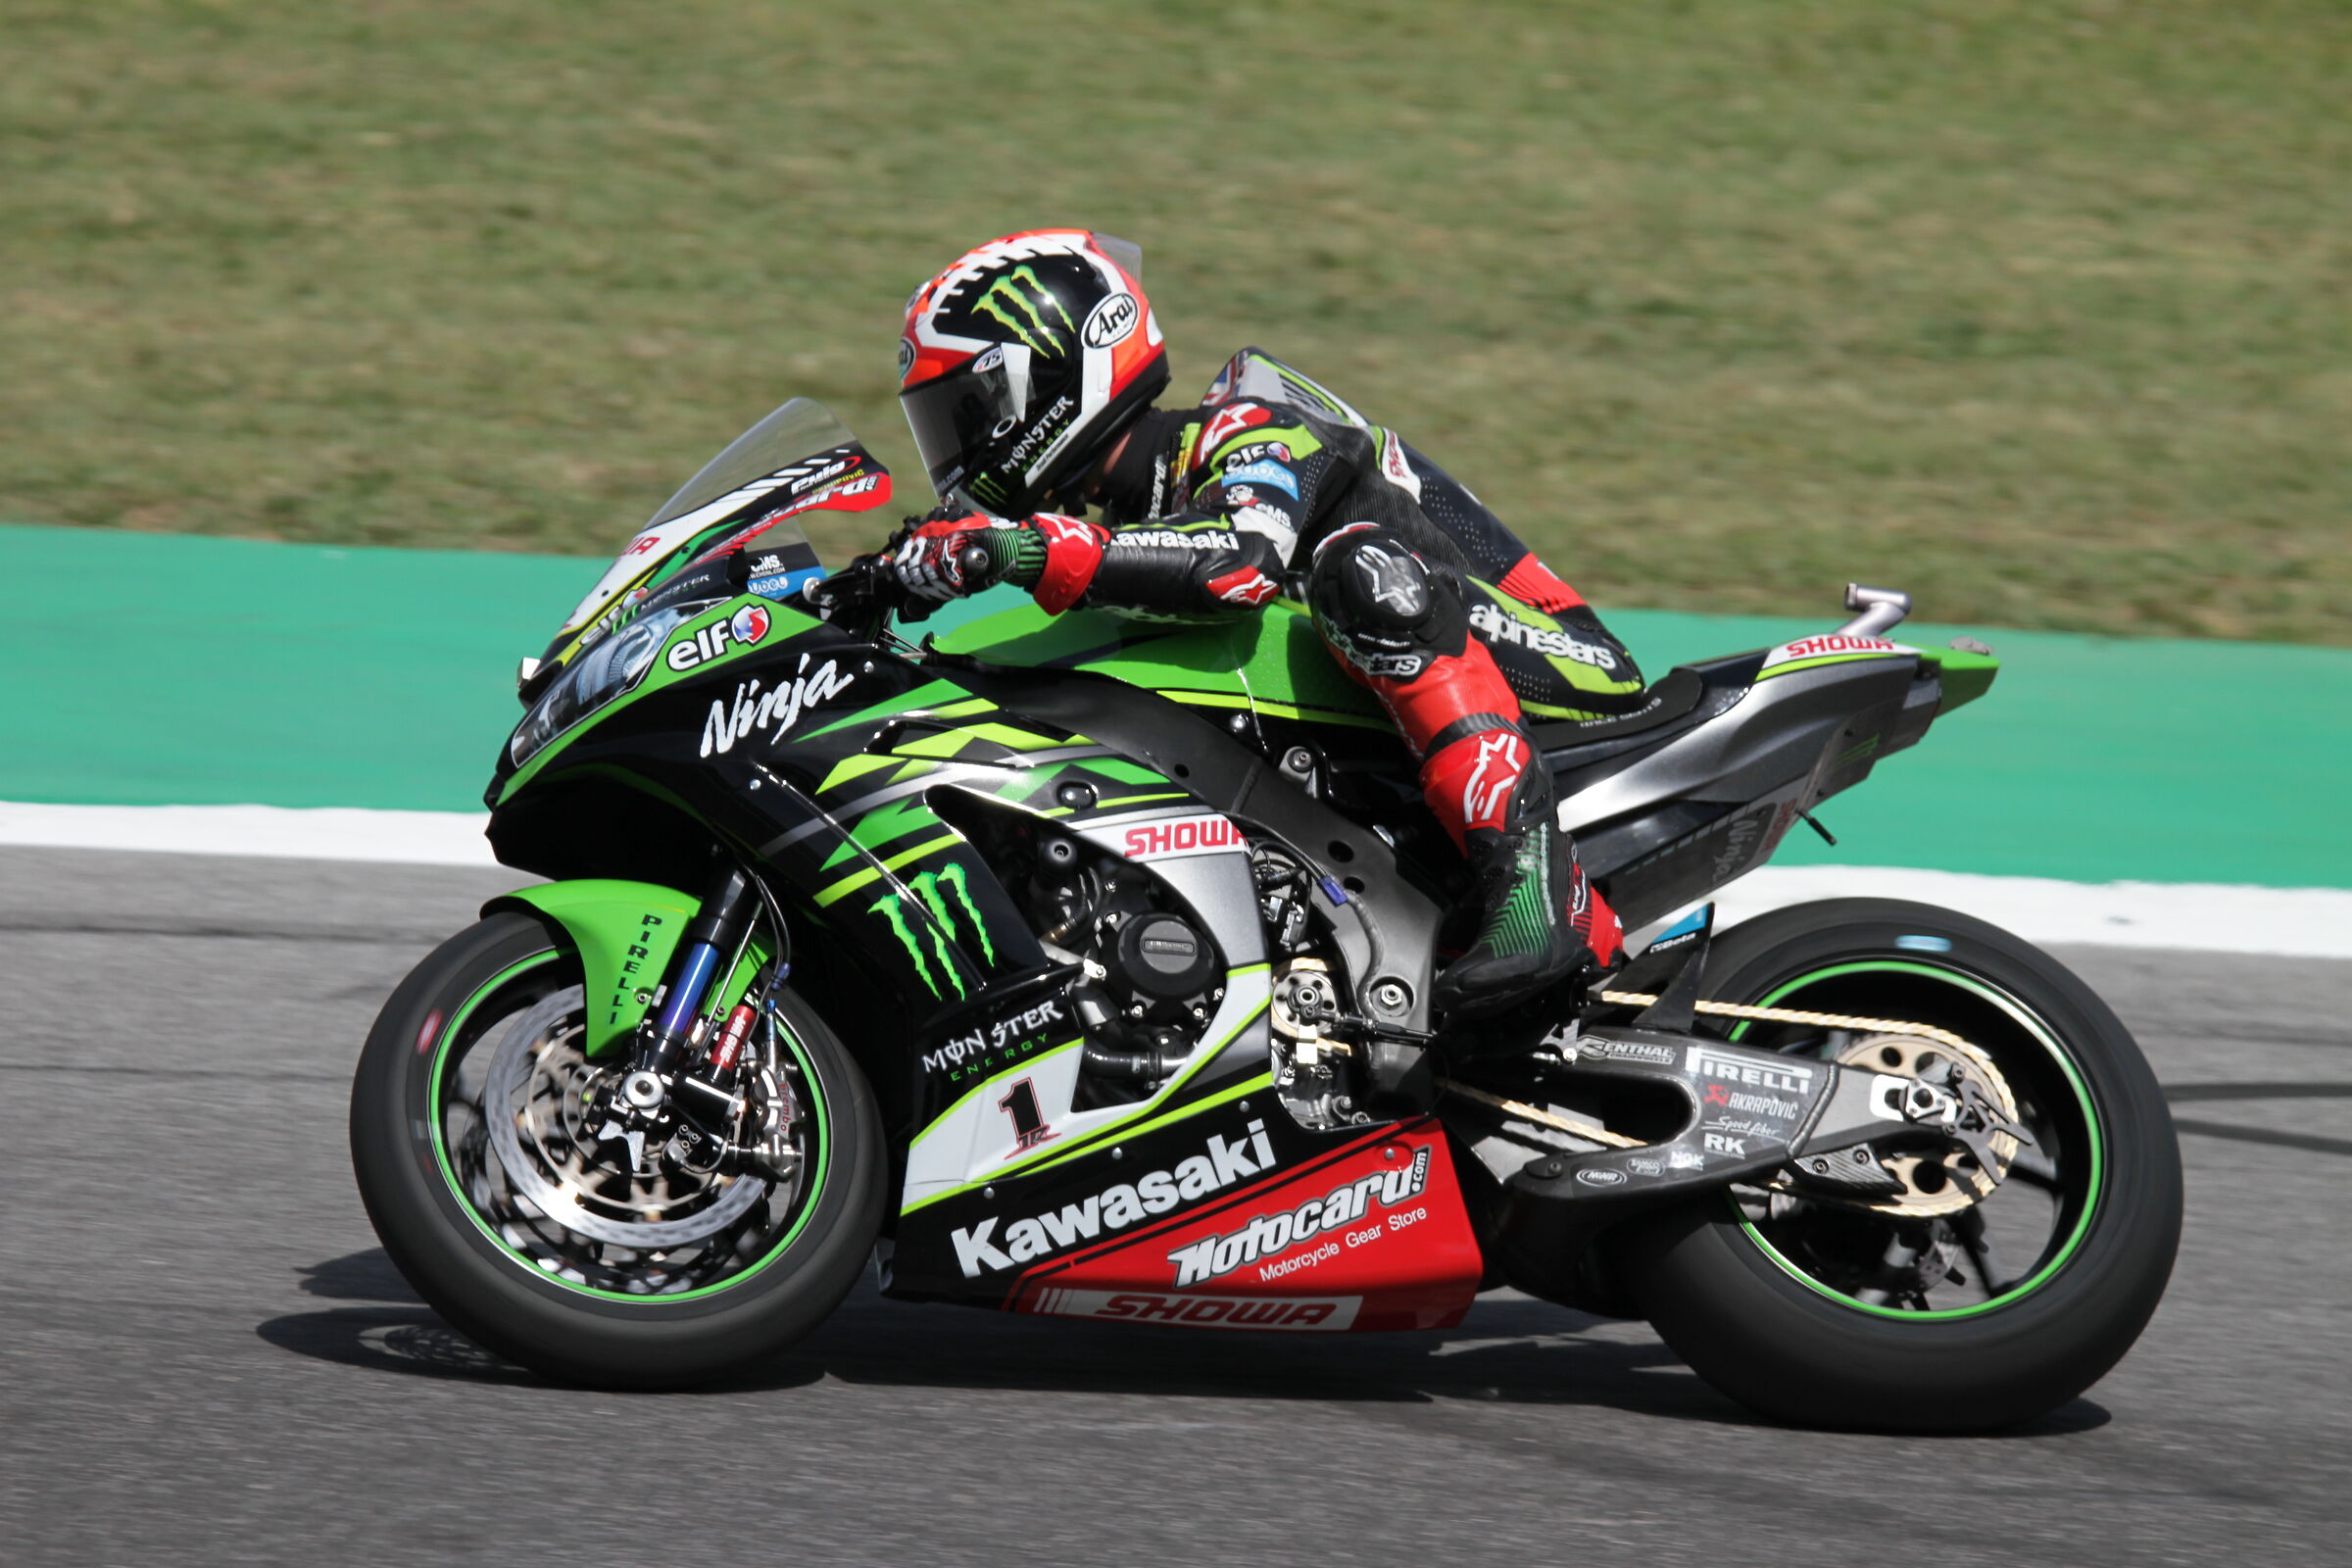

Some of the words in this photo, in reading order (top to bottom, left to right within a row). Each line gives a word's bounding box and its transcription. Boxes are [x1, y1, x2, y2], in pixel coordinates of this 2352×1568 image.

[1093, 295, 1134, 346] Arai
[1000, 395, 1075, 475] MONSTER
[1225, 444, 1265, 473] elf
[666, 618, 731, 672] elf
[1469, 603, 1617, 670] alpinestars
[1786, 635, 1893, 658] SHOWA
[699, 652, 855, 759] Ninja
[609, 912, 663, 1026] PIRELLI
[921, 1000, 1064, 1074] MONSTER
[950, 1033, 1048, 1082] ENERGY
[1685, 1046, 1813, 1095] PIRELLI
[998, 1076, 1045, 1145] 1
[1703, 1132, 1746, 1155] RK
[950, 1117, 1277, 1279] Kawasaki
[1258, 1241, 1341, 1283] Motorcycle
[1345, 1223, 1383, 1250] Gear
[1388, 1206, 1428, 1233] Store
[1093, 1295, 1338, 1326] SHOWA
